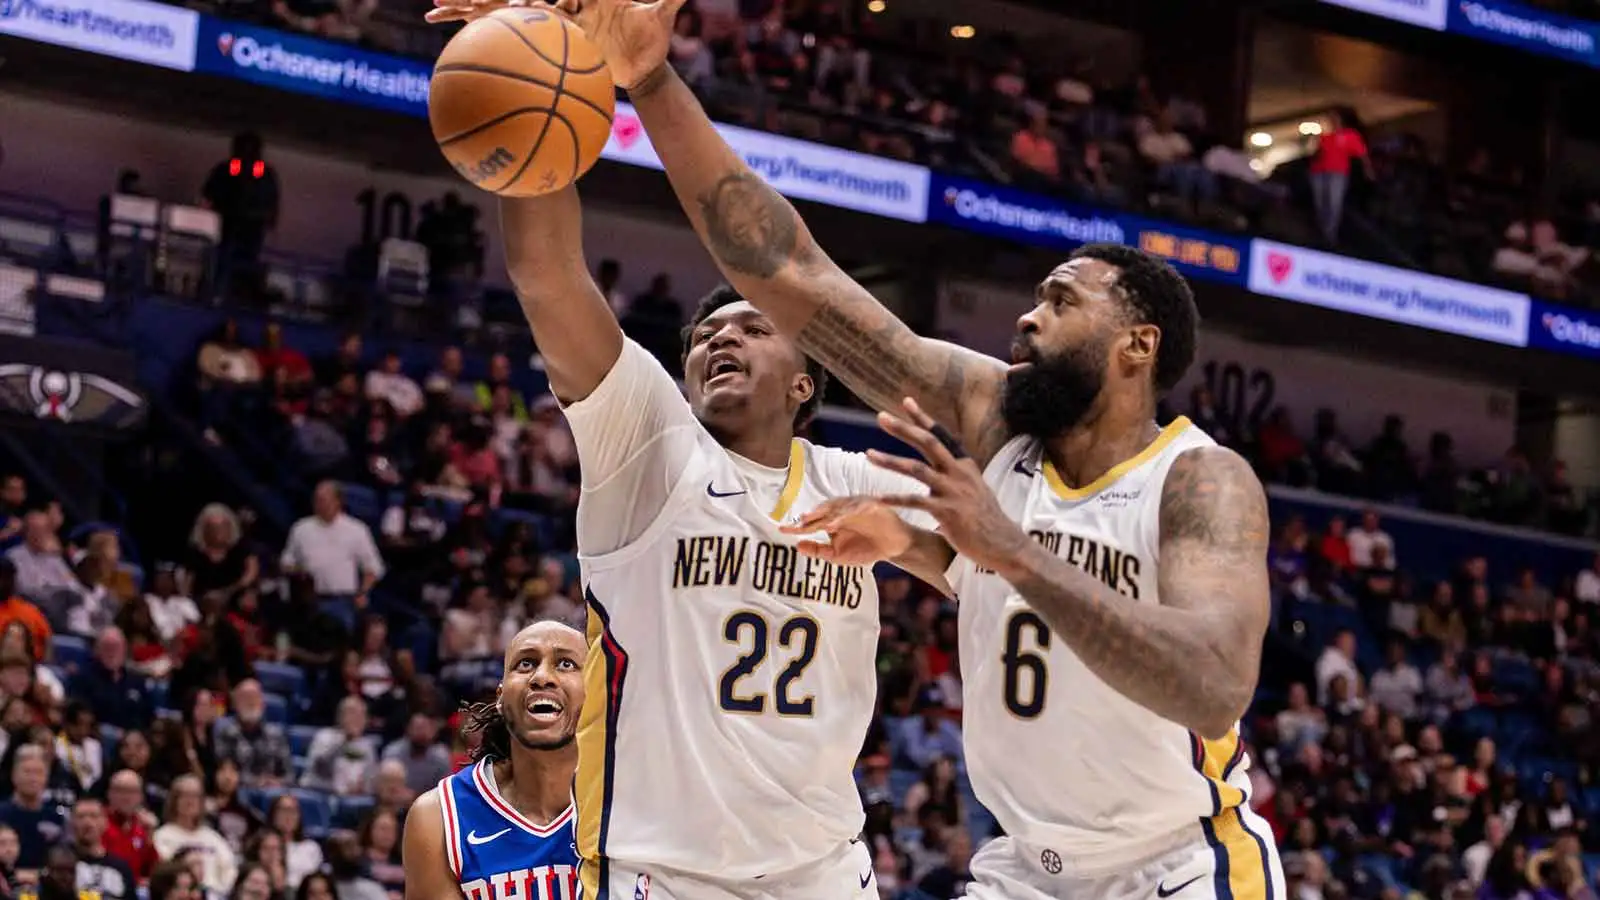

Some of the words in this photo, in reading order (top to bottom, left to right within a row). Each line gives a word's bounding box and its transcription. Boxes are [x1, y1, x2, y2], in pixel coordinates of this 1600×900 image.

[672, 535, 750, 589] NEW
[752, 540, 864, 610] ORLEANS
[716, 607, 822, 719] 22
[1001, 609, 1051, 721] 6
